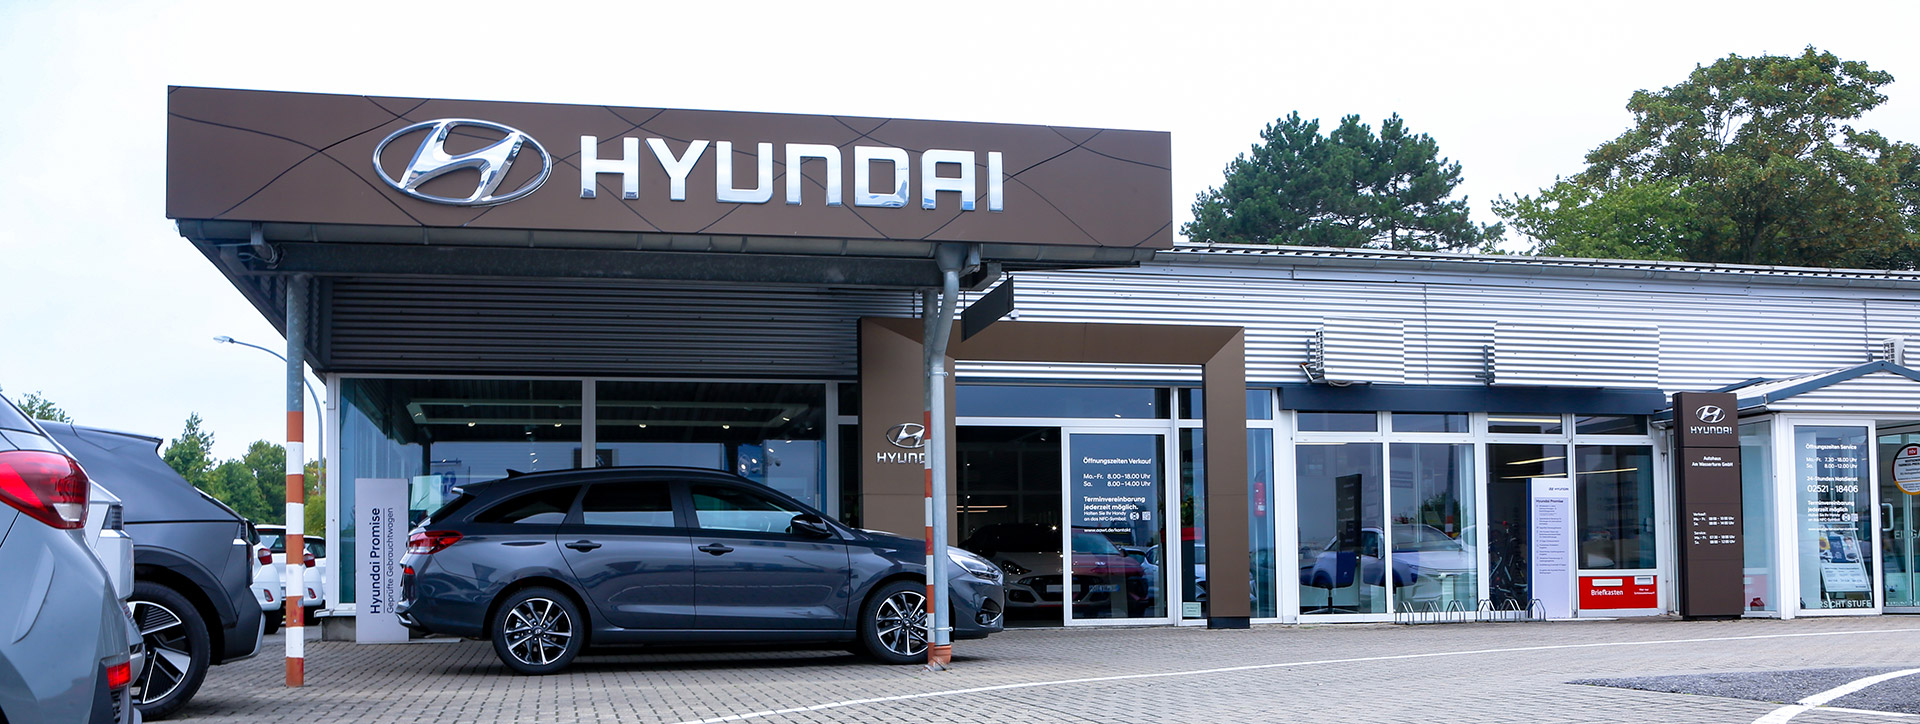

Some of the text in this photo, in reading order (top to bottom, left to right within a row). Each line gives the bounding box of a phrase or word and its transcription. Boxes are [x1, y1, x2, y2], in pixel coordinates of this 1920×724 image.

[580, 135, 1004, 212] HYUNDAI
[1690, 426, 1732, 434] HYUNDAI
[877, 452, 926, 464] HYUND
[1083, 456, 1128, 465] Öffnungszeiten
[369, 508, 382, 614] Hyundai Promise
[387, 508, 395, 614] Geprüfte Gebrauchtwagen
